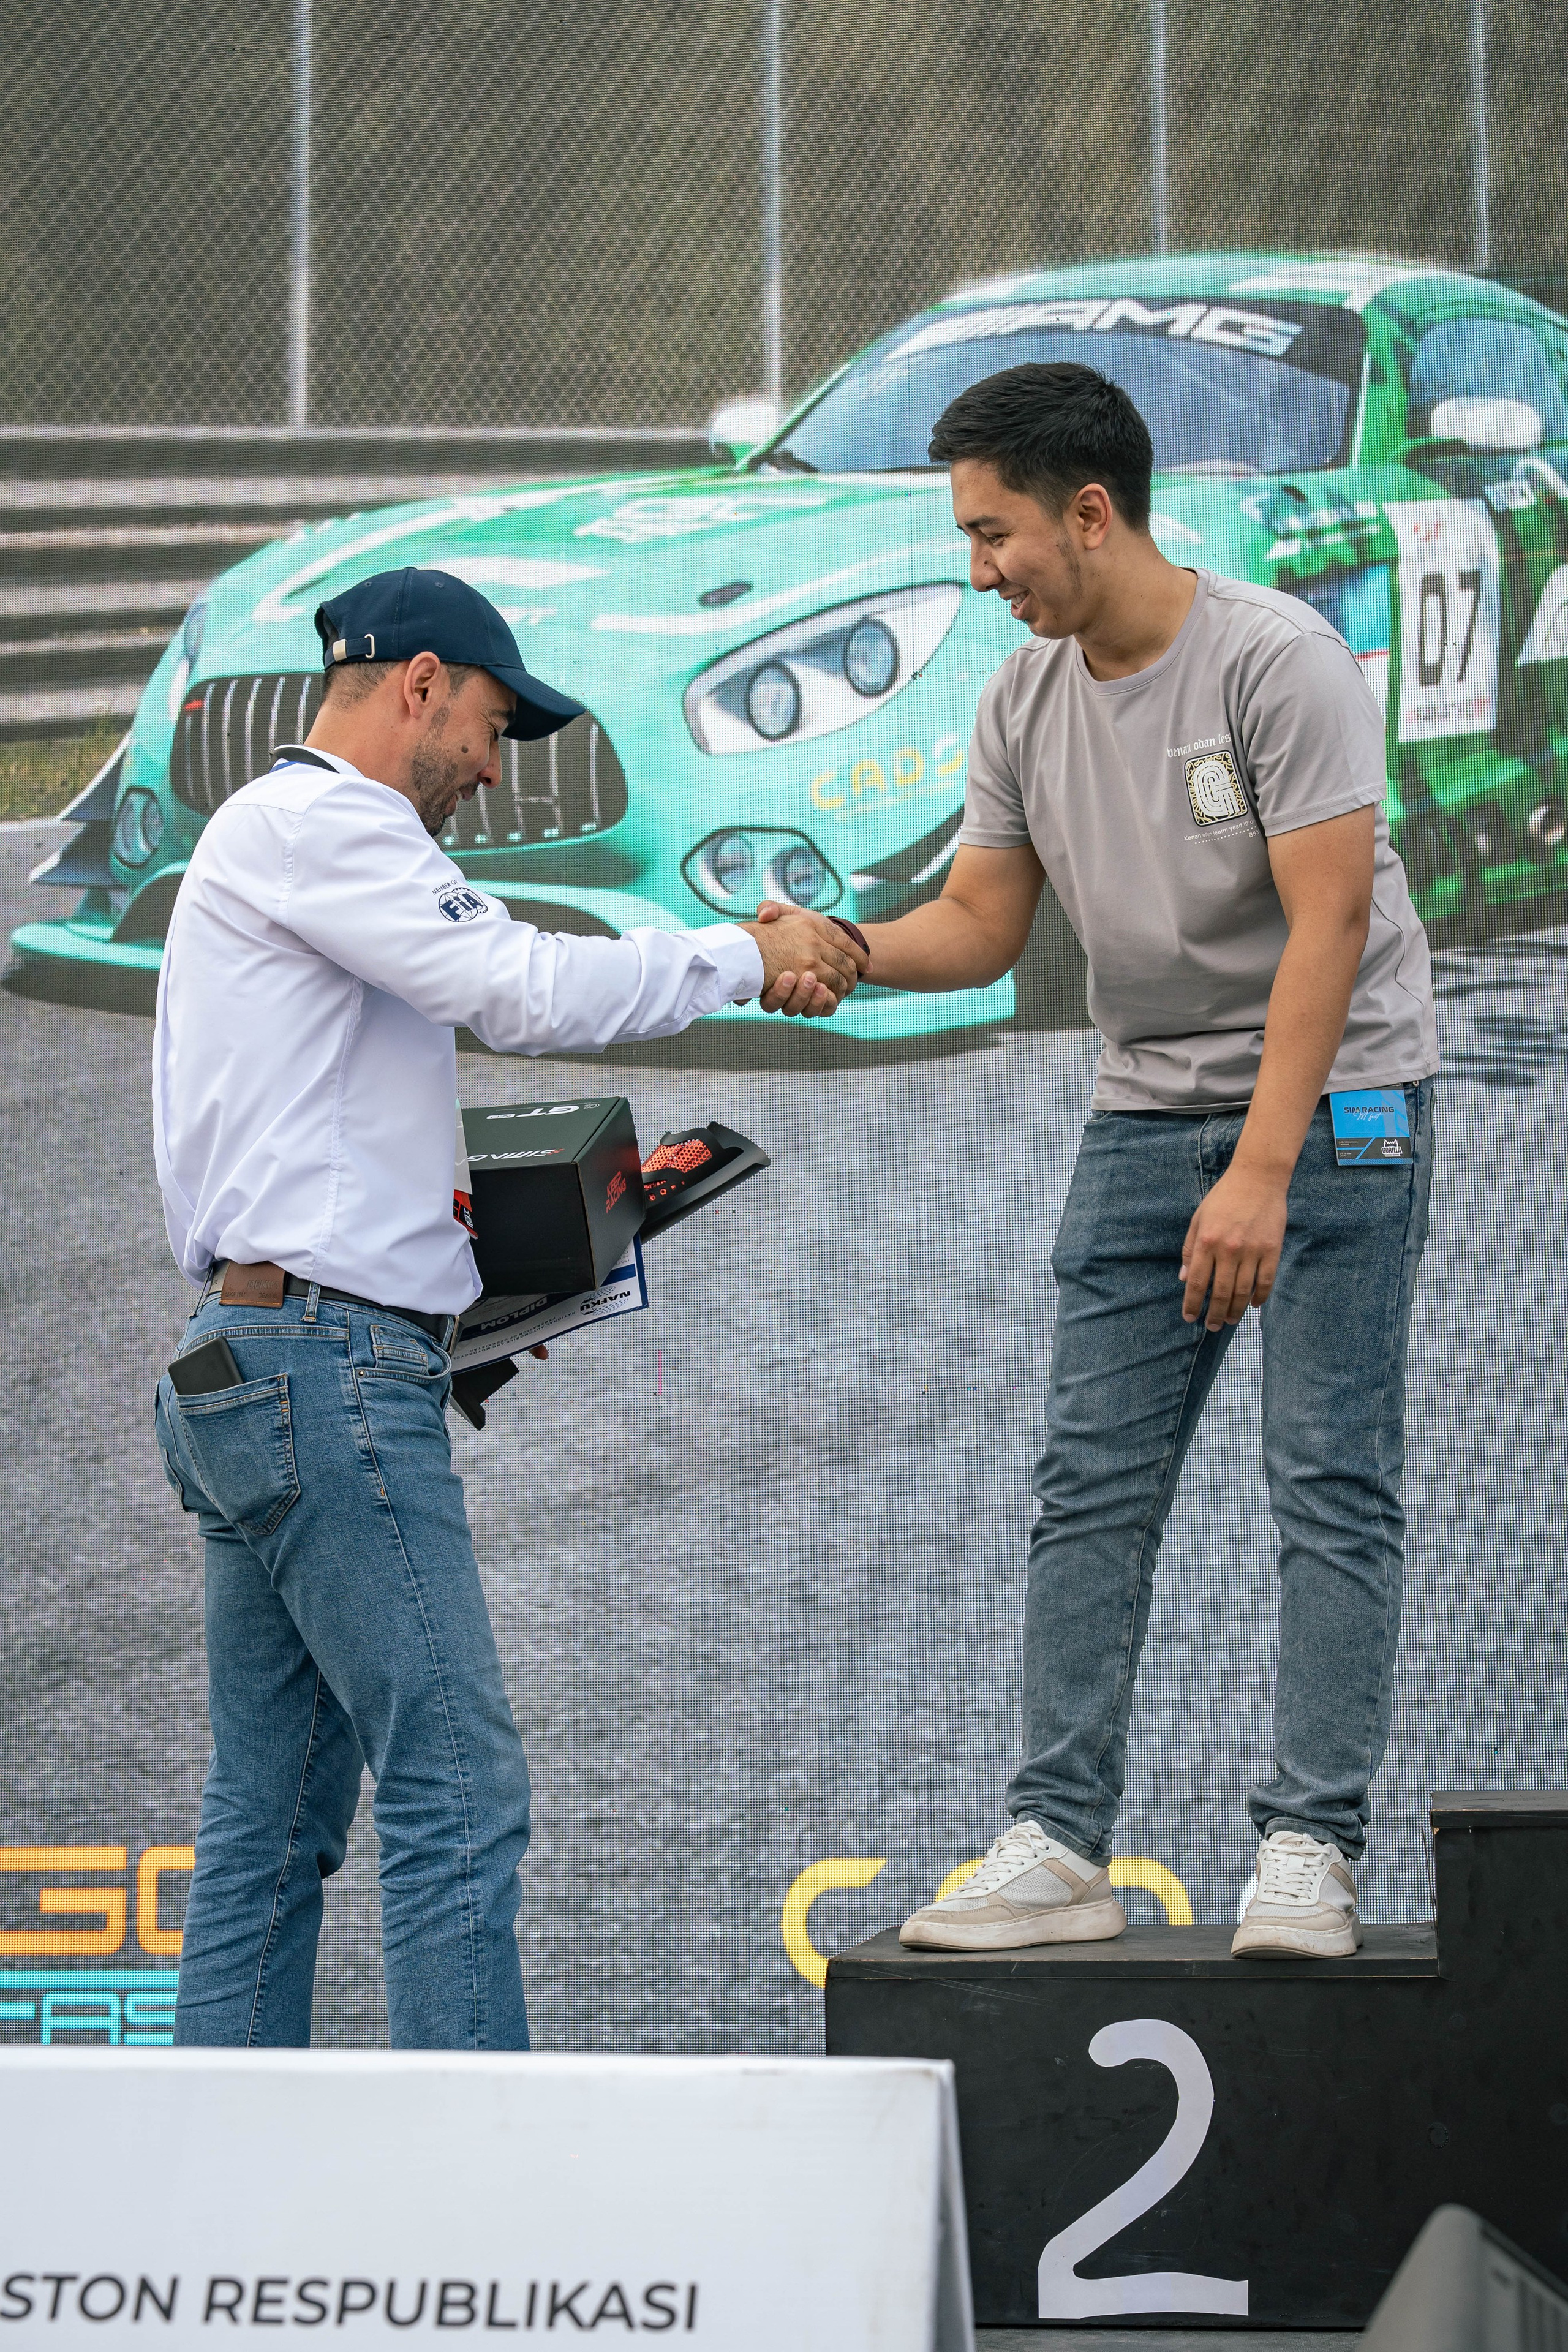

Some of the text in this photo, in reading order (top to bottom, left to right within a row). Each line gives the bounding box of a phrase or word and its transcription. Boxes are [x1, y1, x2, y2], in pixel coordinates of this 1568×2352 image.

[1419, 573, 1480, 687] 07
[432, 882, 451, 895] MEMBER
[516, 1105, 580, 1118] GT
[1382, 1146, 1402, 1155] GORILLA
[606, 1170, 622, 1198] KEEP
[606, 1178, 627, 1214] RACING
[580, 1291, 631, 1311] NAFKU
[481, 1297, 548, 1331] DIPLOM
[546, 1311, 576, 1326] NATIONAL
[506, 1325, 545, 1344] AUTOMOBILE
[1038, 2019, 1249, 2319] 2
[0, 2274, 698, 2331] STON RESPUBLIKASI
